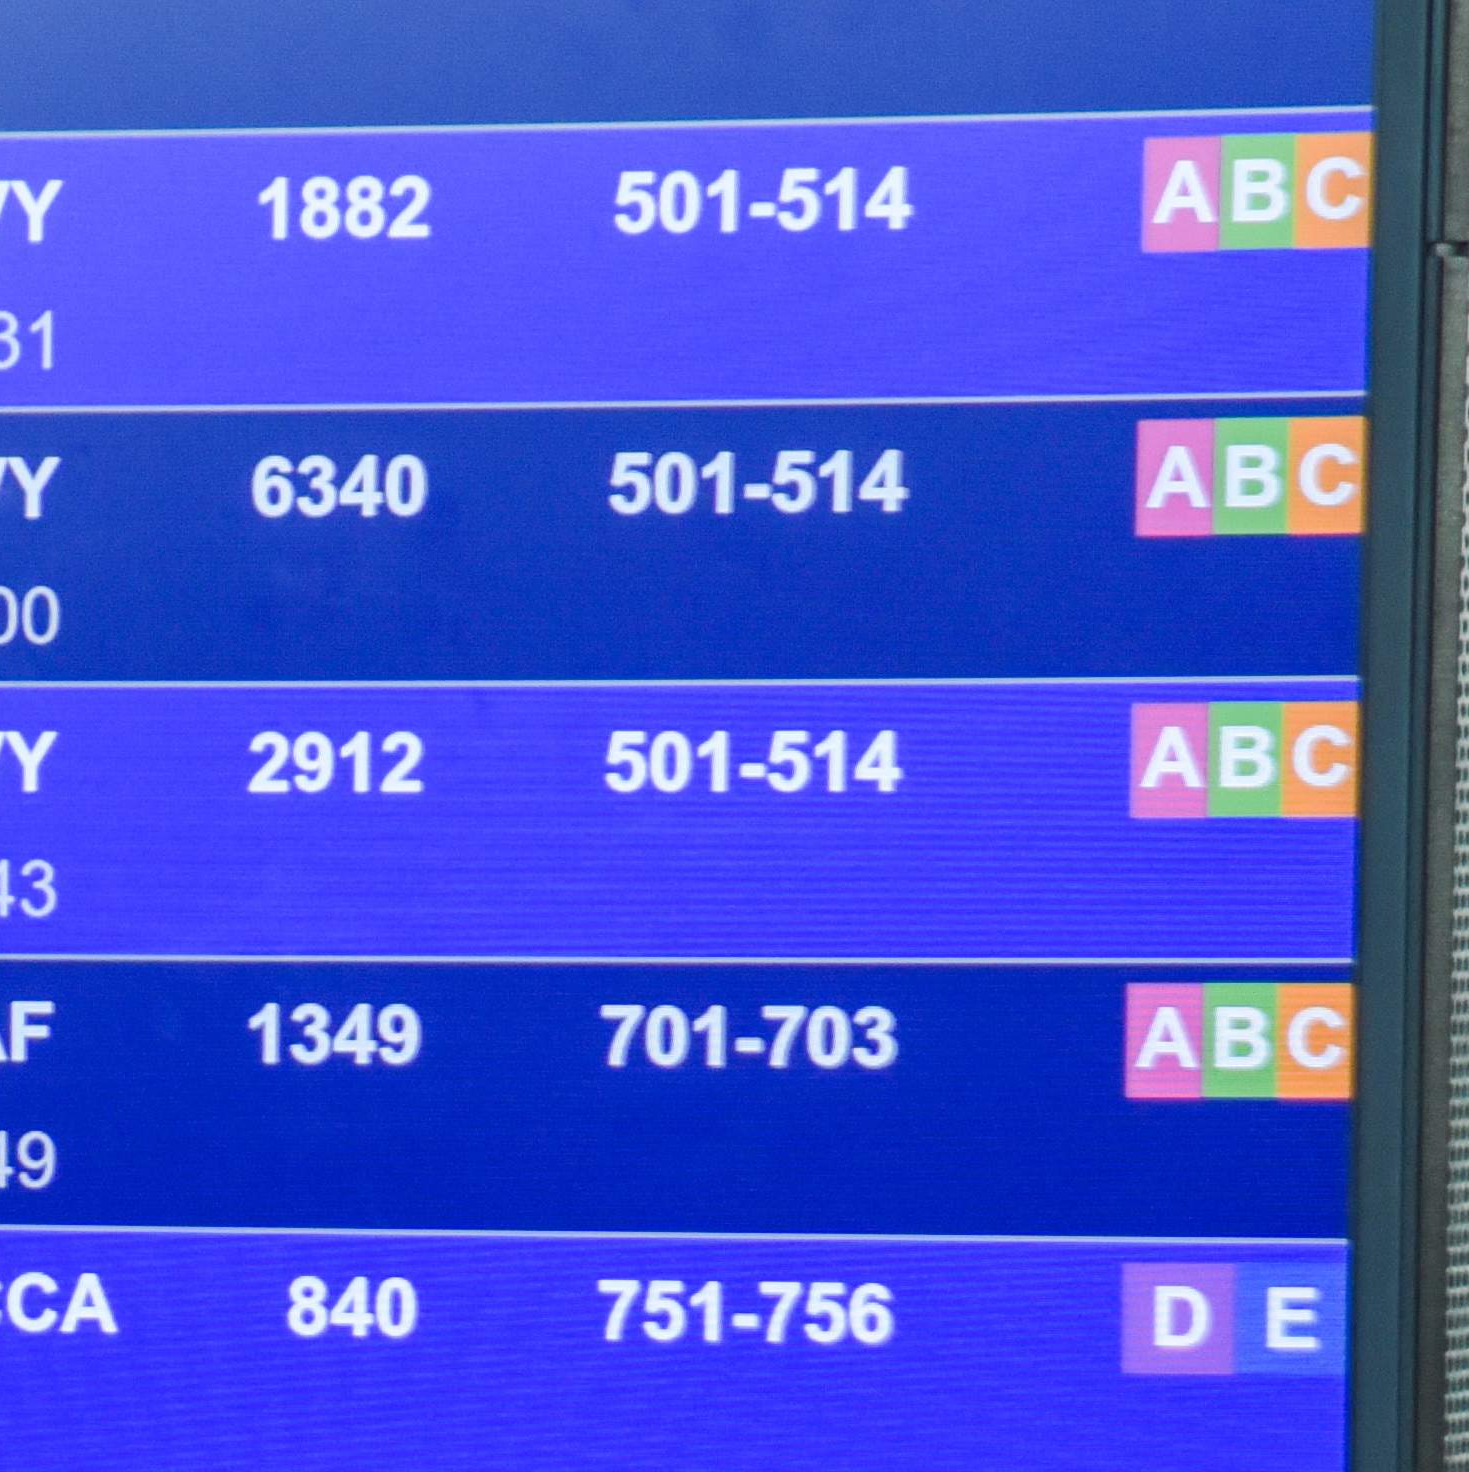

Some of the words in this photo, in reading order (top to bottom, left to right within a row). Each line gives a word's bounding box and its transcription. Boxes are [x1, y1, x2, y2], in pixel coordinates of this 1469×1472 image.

[256, 173, 434, 242] 1882
[612, 164, 916, 237] 501-514
[250, 453, 428, 519] 6340
[608, 448, 910, 516] 501-514
[245, 729, 425, 795] 2912
[603, 728, 905, 795] 501-514
[247, 1001, 421, 1067] 1349
[599, 1003, 897, 1070] 701-703
[285, 1274, 419, 1340] 840
[596, 1278, 895, 1347] 751-756
